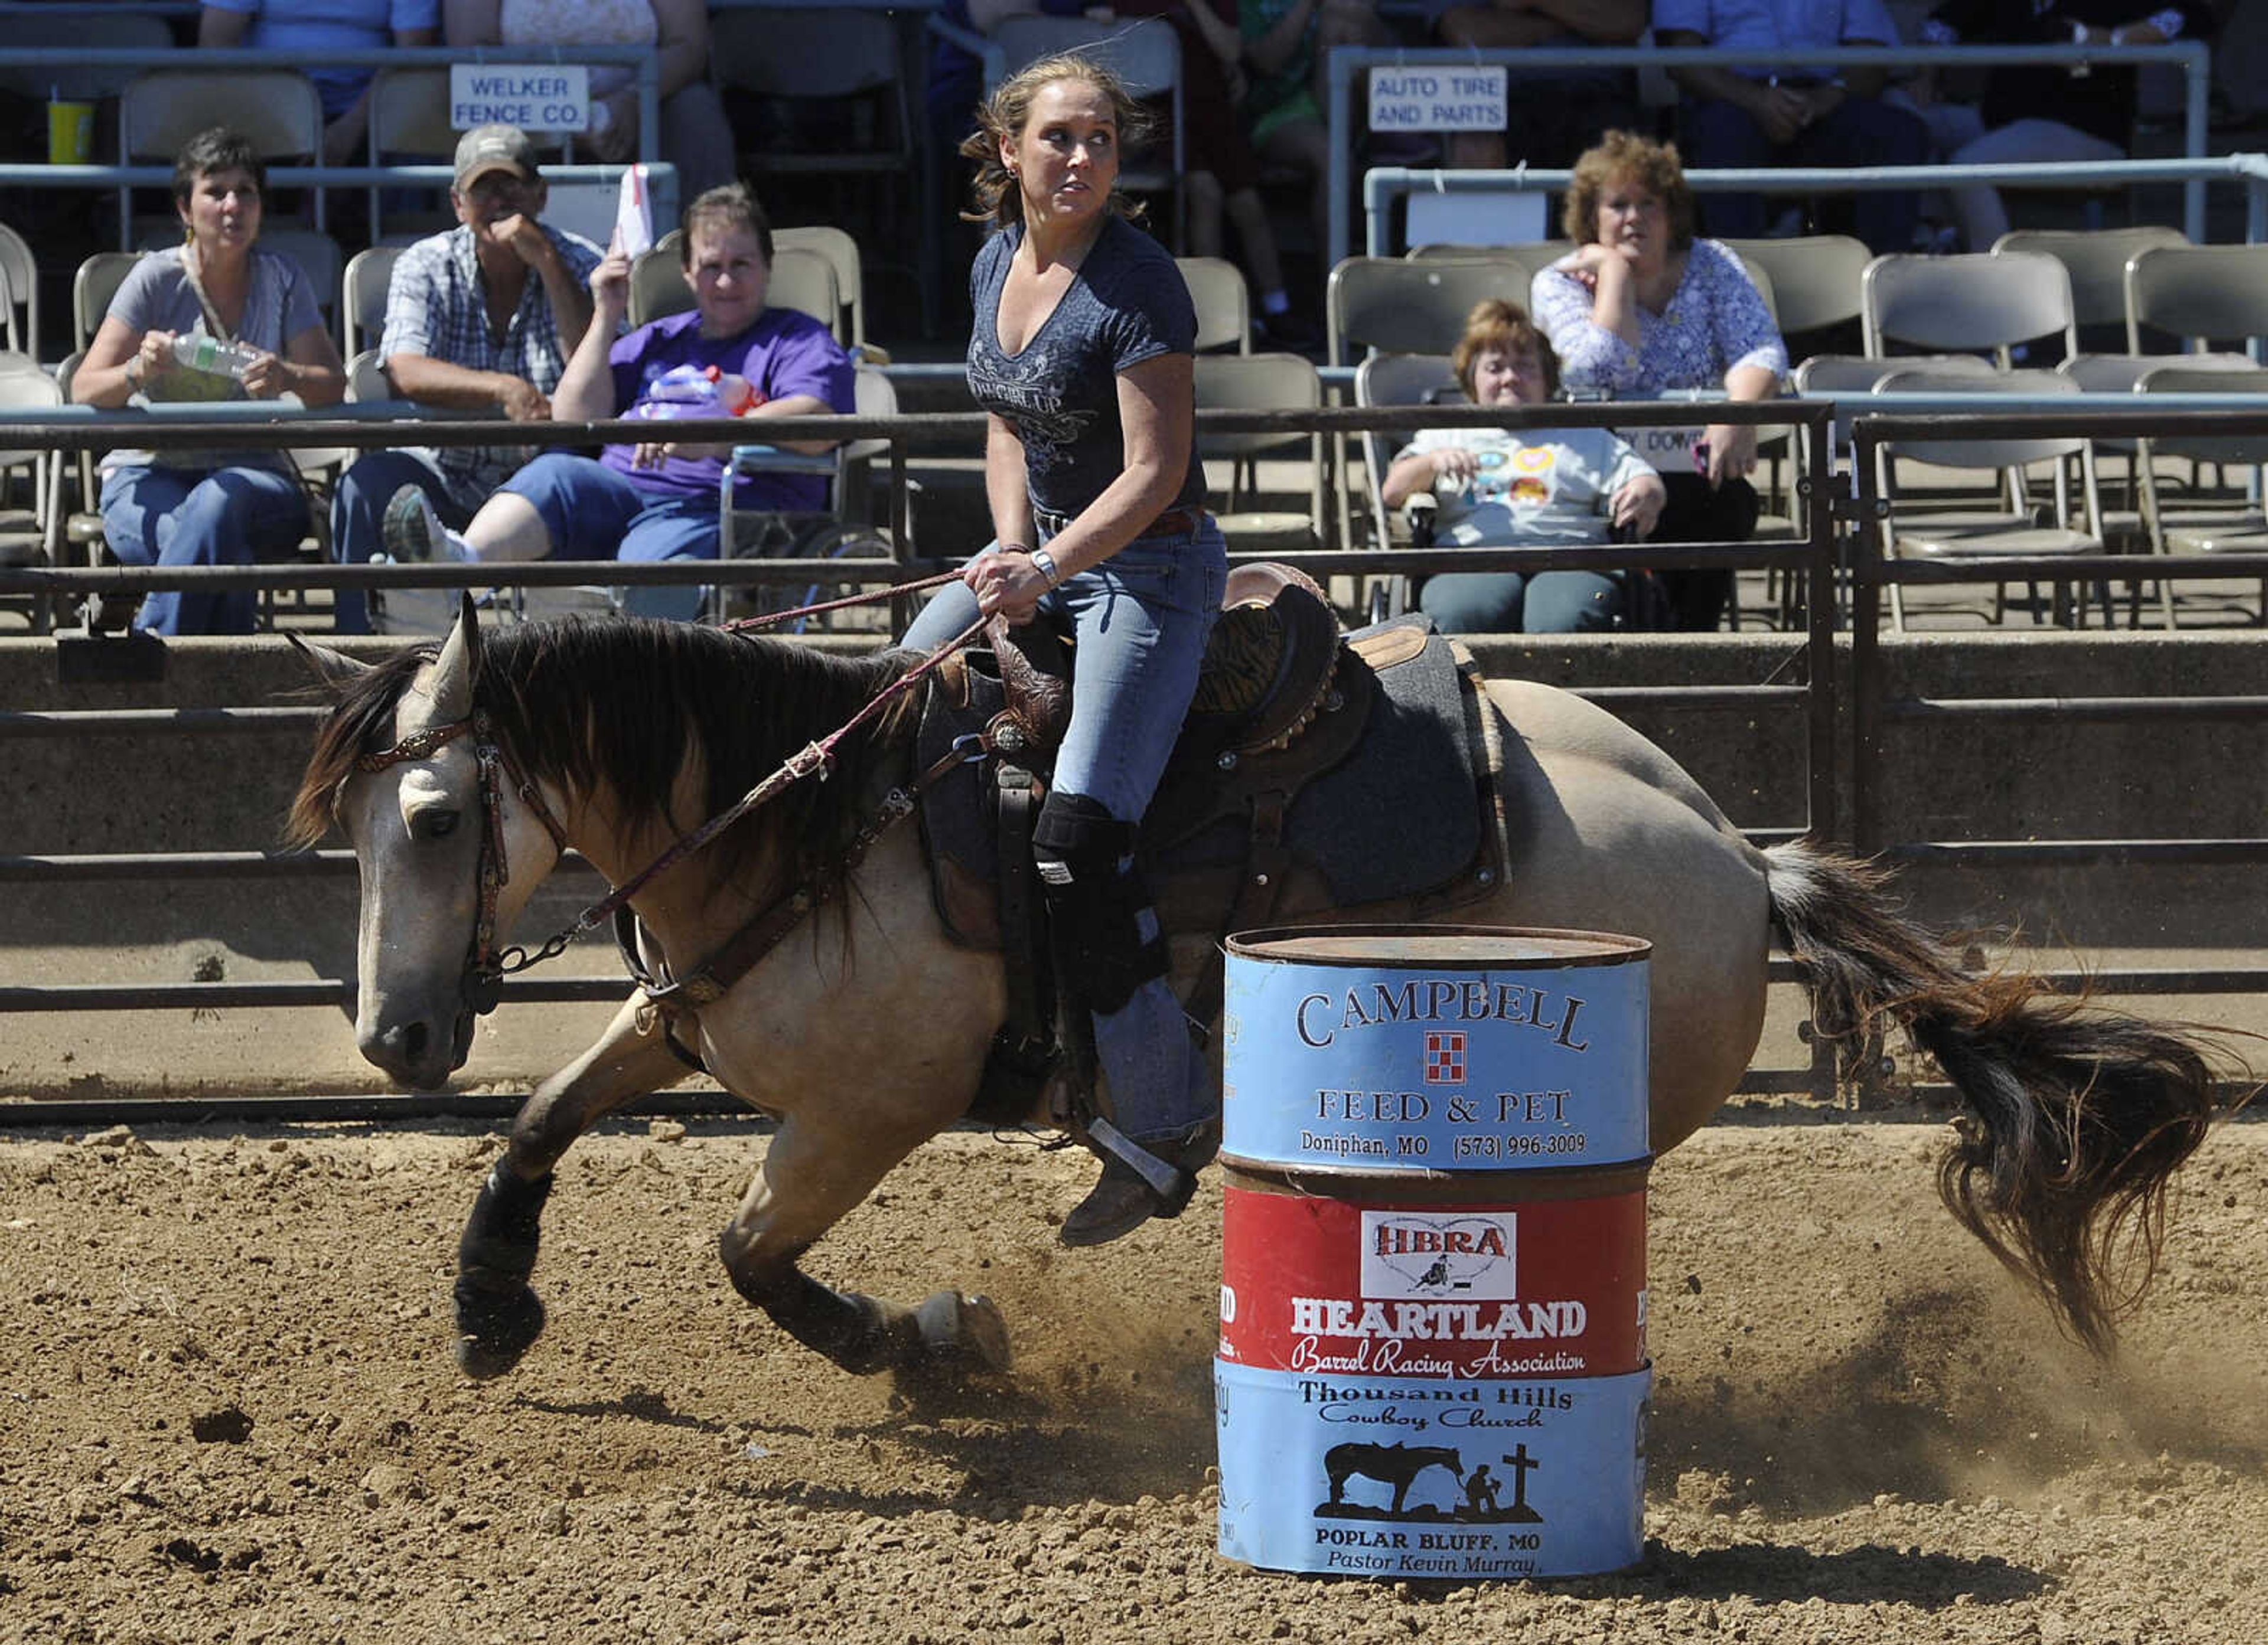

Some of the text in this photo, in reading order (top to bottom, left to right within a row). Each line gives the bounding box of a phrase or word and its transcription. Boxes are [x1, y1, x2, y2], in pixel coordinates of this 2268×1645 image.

[471, 78, 568, 97] WELKER
[1376, 77, 1500, 97] AUTO TIRE
[455, 104, 532, 123] FENCE
[1377, 105, 1500, 125] AND PARTS
[1034, 392, 1061, 413] UP
[1296, 979, 1589, 1053] CAMPBELL
[1317, 1089, 1571, 1122] FEED & PET
[1301, 1130, 1586, 1161] Doniphan, MO (573) 996-3009
[1376, 1224, 1506, 1257] HBRA
[1291, 1297, 1588, 1341] HEARTLAND
[1292, 1336, 1586, 1380] Barrel Racing Association
[1298, 1381, 1573, 1411] Thousand Hills
[1319, 1404, 1544, 1431] Cowboy Church
[1315, 1528, 1409, 1549] POPLAR
[1508, 1534, 1542, 1551] MO
[1327, 1551, 1394, 1569] Pastor
[1399, 1554, 1458, 1572] Kevin
